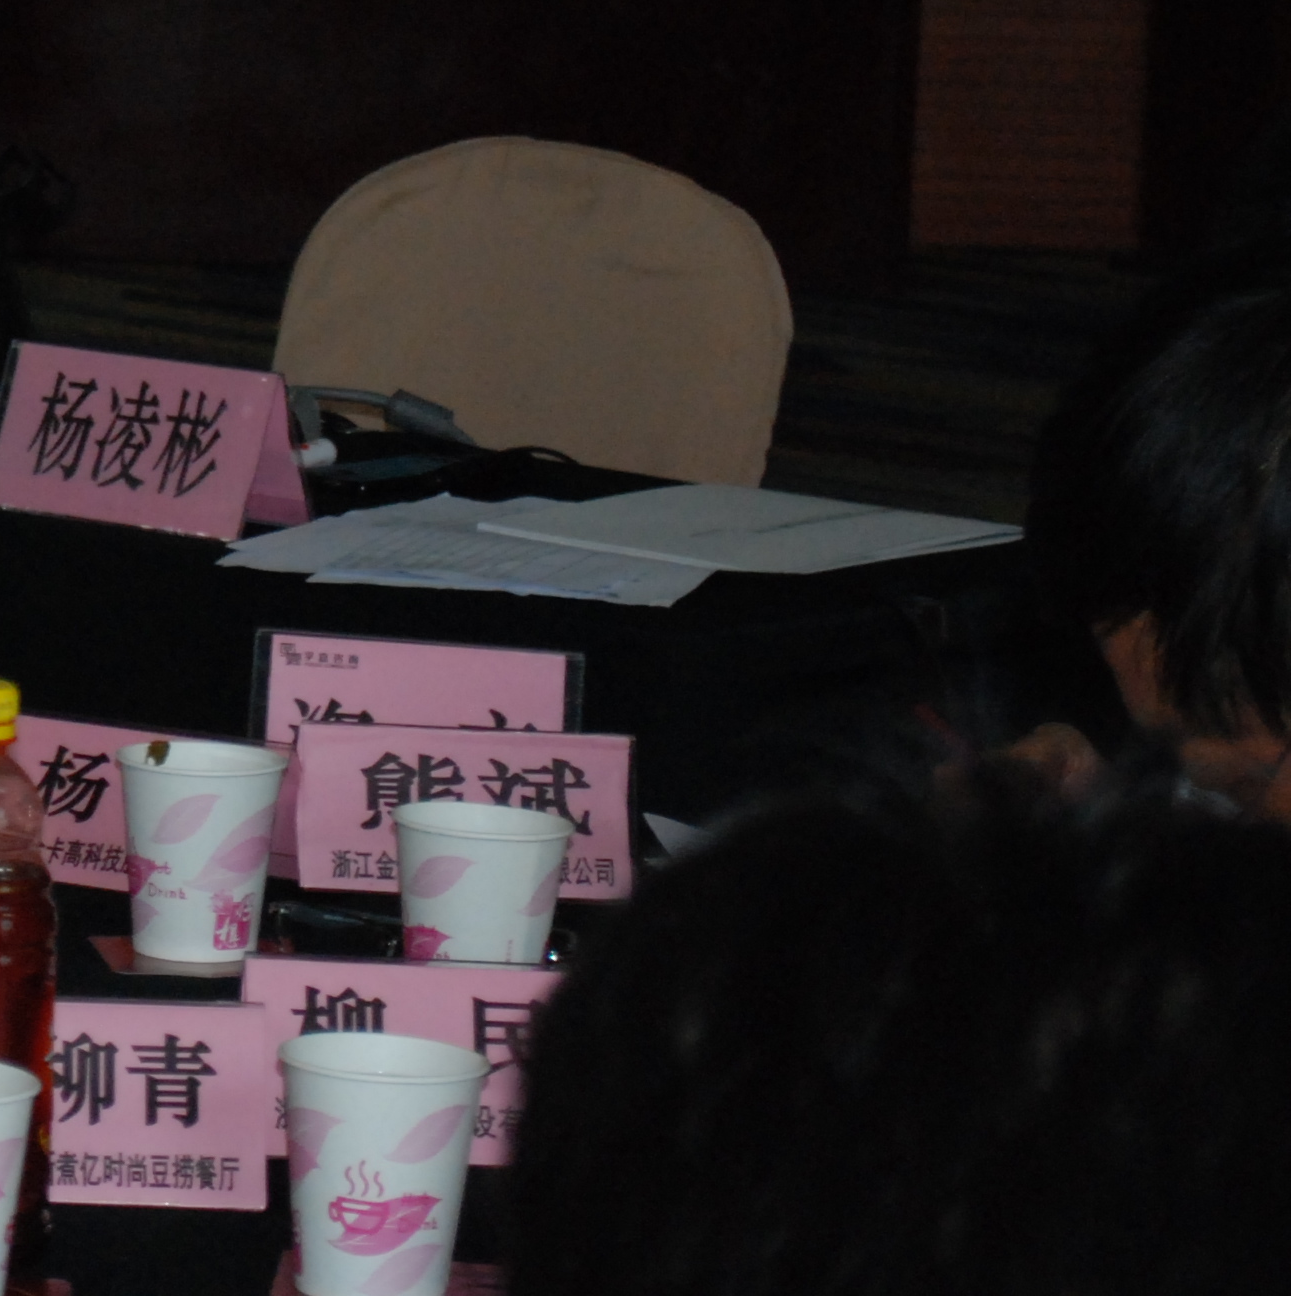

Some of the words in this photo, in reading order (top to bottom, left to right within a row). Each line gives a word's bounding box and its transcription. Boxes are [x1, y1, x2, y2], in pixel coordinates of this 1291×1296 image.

[28, 372, 228, 497] 杨凌彬
[37, 745, 110, 822] 杨
[39, 836, 130, 874] 卡高科技
[47, 1032, 217, 1128] 柳青
